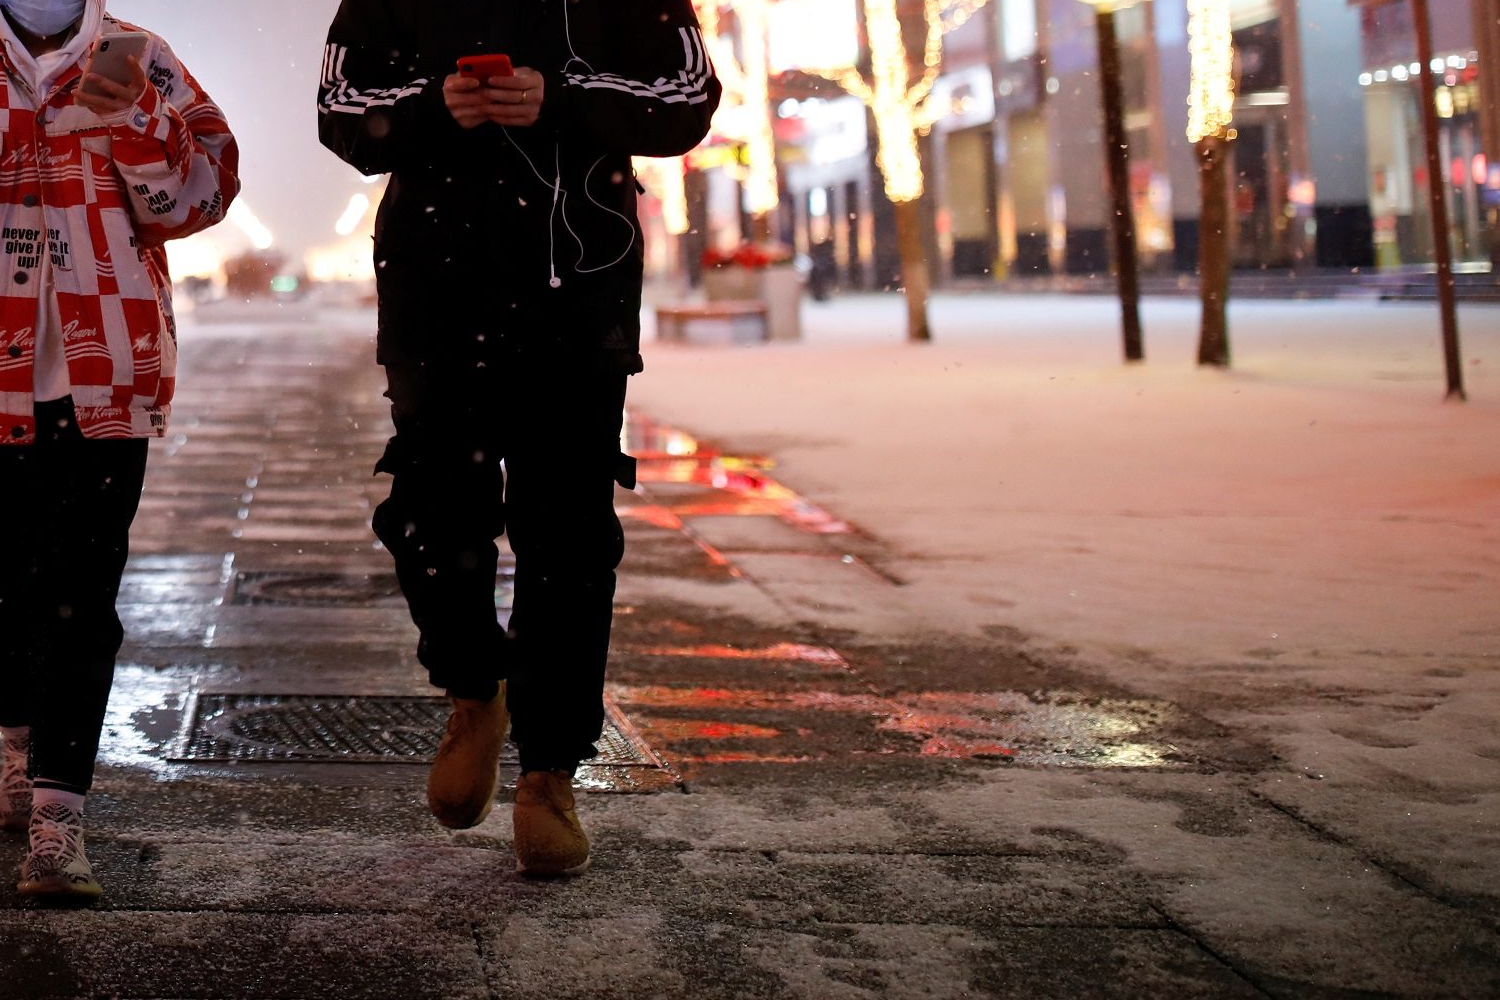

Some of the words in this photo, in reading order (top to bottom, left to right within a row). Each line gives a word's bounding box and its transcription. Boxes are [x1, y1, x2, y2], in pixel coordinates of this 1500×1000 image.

[2, 228, 40, 240] never
[5, 240, 34, 254] give
[36, 242, 45, 255] it
[60, 242, 68, 254] it
[17, 256, 39, 269] up!
